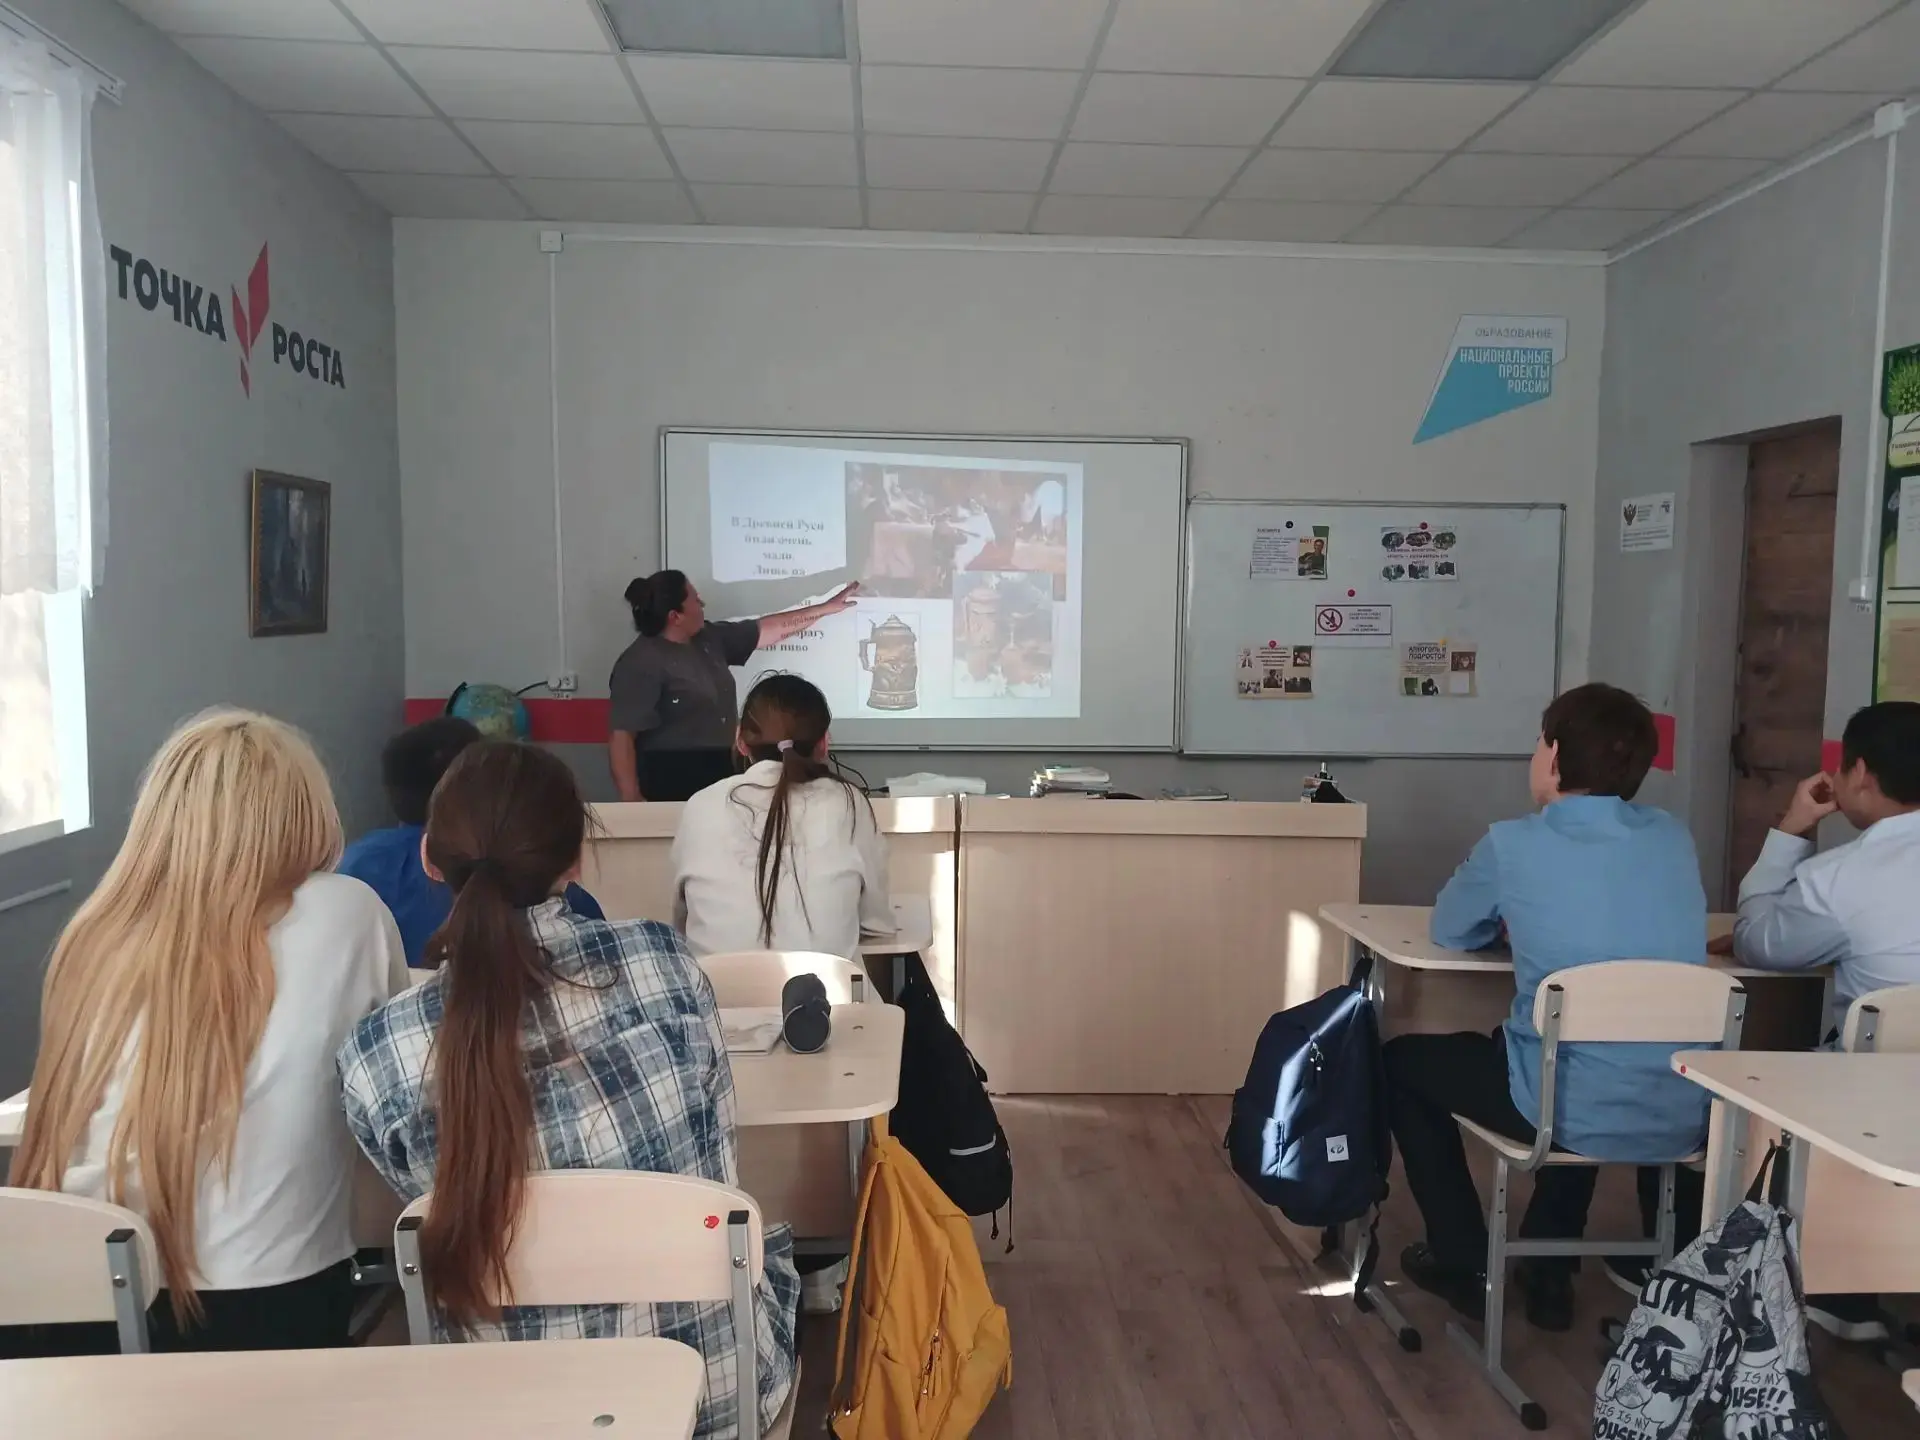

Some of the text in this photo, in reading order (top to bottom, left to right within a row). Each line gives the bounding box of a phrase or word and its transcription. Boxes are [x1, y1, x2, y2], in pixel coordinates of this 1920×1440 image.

[110, 243, 346, 389] ТОЧКА РОСТА
[1475, 327, 1553, 339] ОБРАЗОВАНИЕ
[1459, 348, 1551, 364] НАЦИОНАЛЬНЫЕ
[1499, 364, 1550, 378] ПРОЕКТЫ
[1507, 379, 1550, 393] РОССИИ
[731, 516, 825, 532] В Древней Руси
[1408, 645, 1441, 654] АЛКОГОЛЬ
[1408, 652, 1446, 661] ПОДРОСТОК
[1741, 1371, 1761, 1385] IS
[1764, 1373, 1785, 1386] MY
[1596, 1402, 1651, 1431] HIS IS MY
